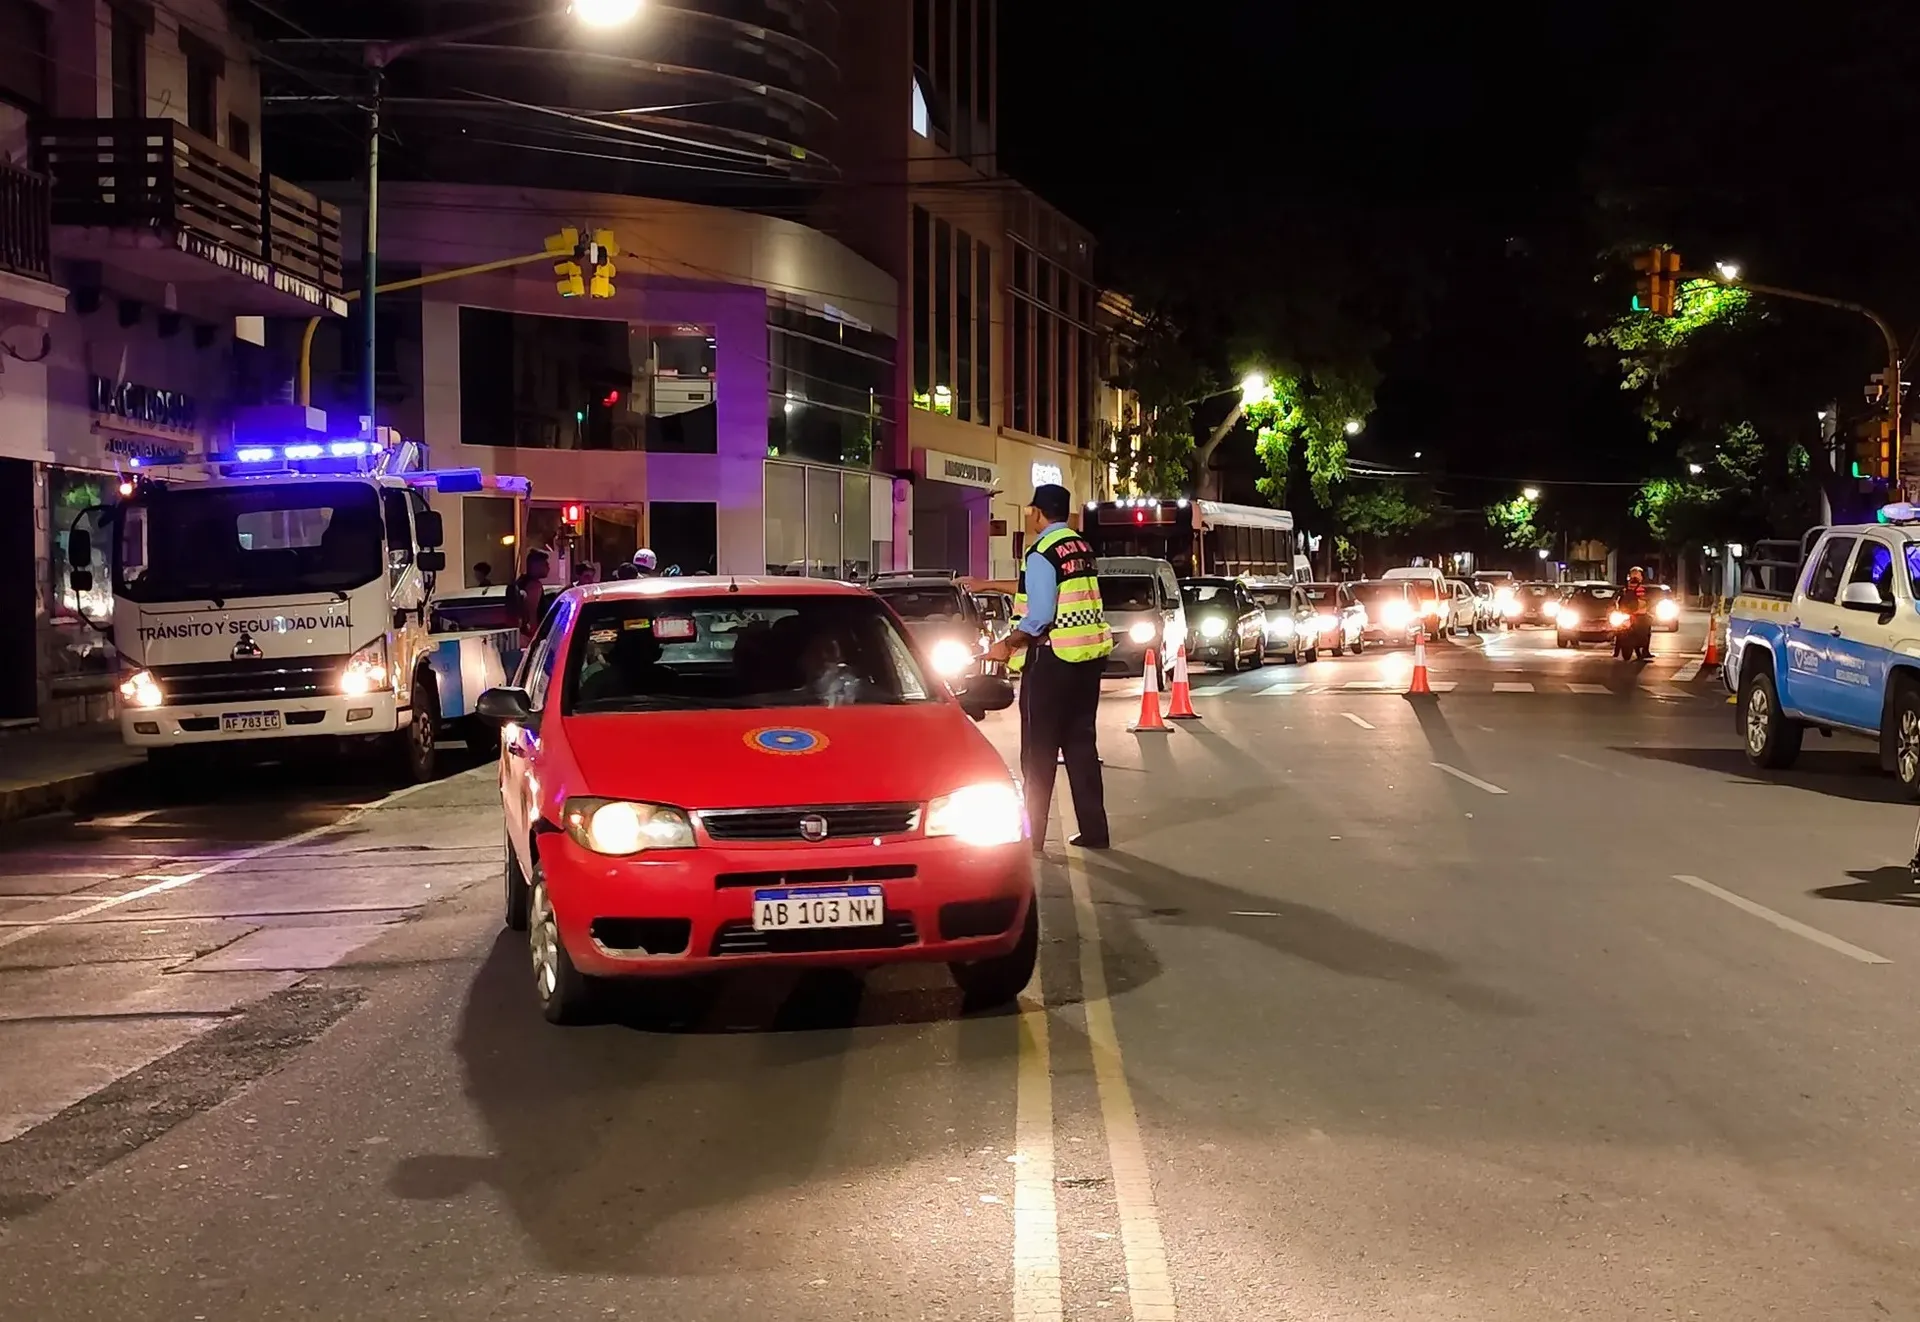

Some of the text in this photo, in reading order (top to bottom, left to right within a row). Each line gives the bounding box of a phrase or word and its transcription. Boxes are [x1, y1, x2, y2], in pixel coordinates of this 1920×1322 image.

[717, 611, 764, 622] TAXI
[137, 614, 354, 641] TRÁNSITO Y SEGURIDAD VIAL
[225, 716, 278, 729] AF 783 EC
[762, 903, 789, 925] AB
[798, 901, 841, 924] 103
